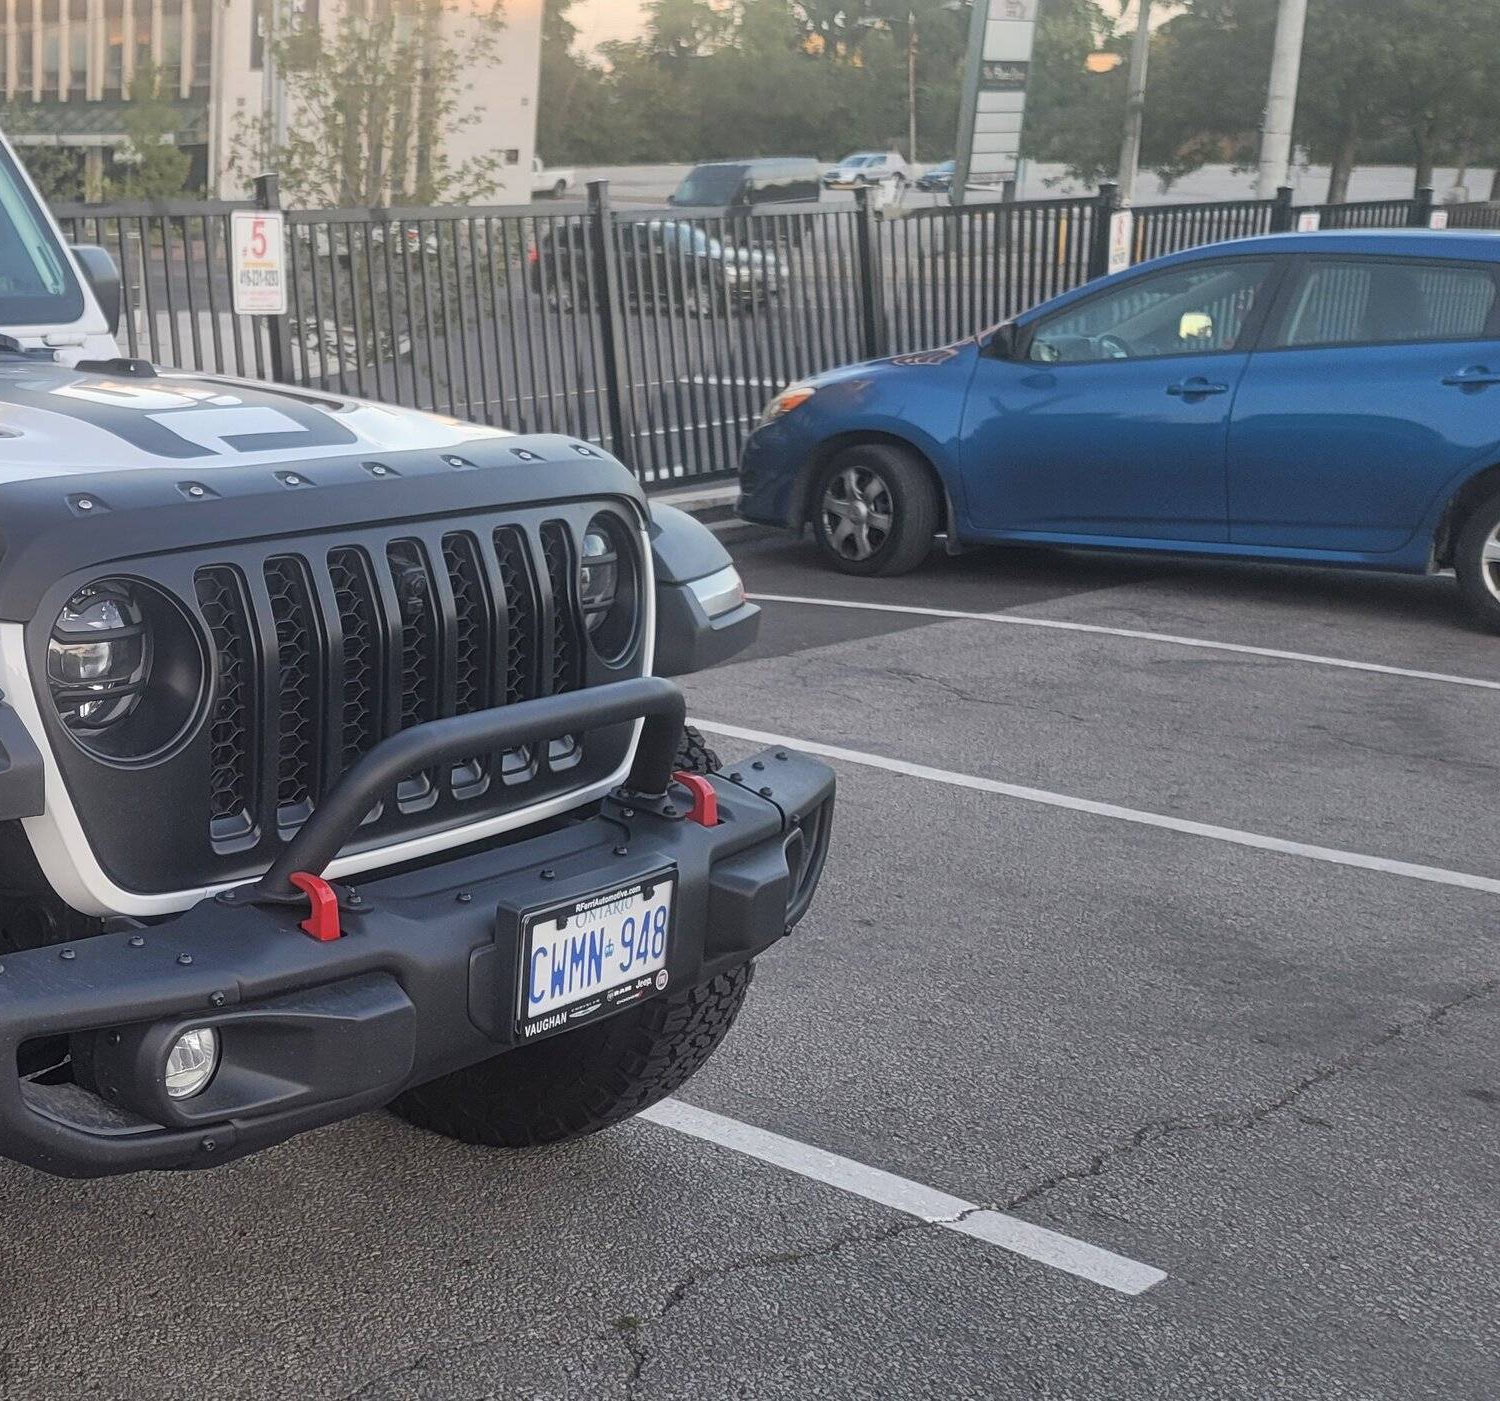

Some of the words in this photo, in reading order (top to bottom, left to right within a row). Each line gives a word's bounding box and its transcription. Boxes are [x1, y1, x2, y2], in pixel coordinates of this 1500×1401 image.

[251, 220, 267, 259] 5
[575, 898, 634, 929] ONTARIO
[529, 927, 605, 1004] CWMN
[619, 905, 667, 972] 948
[524, 1011, 567, 1038] VAUGHAN
[635, 977, 652, 989] Jeep
